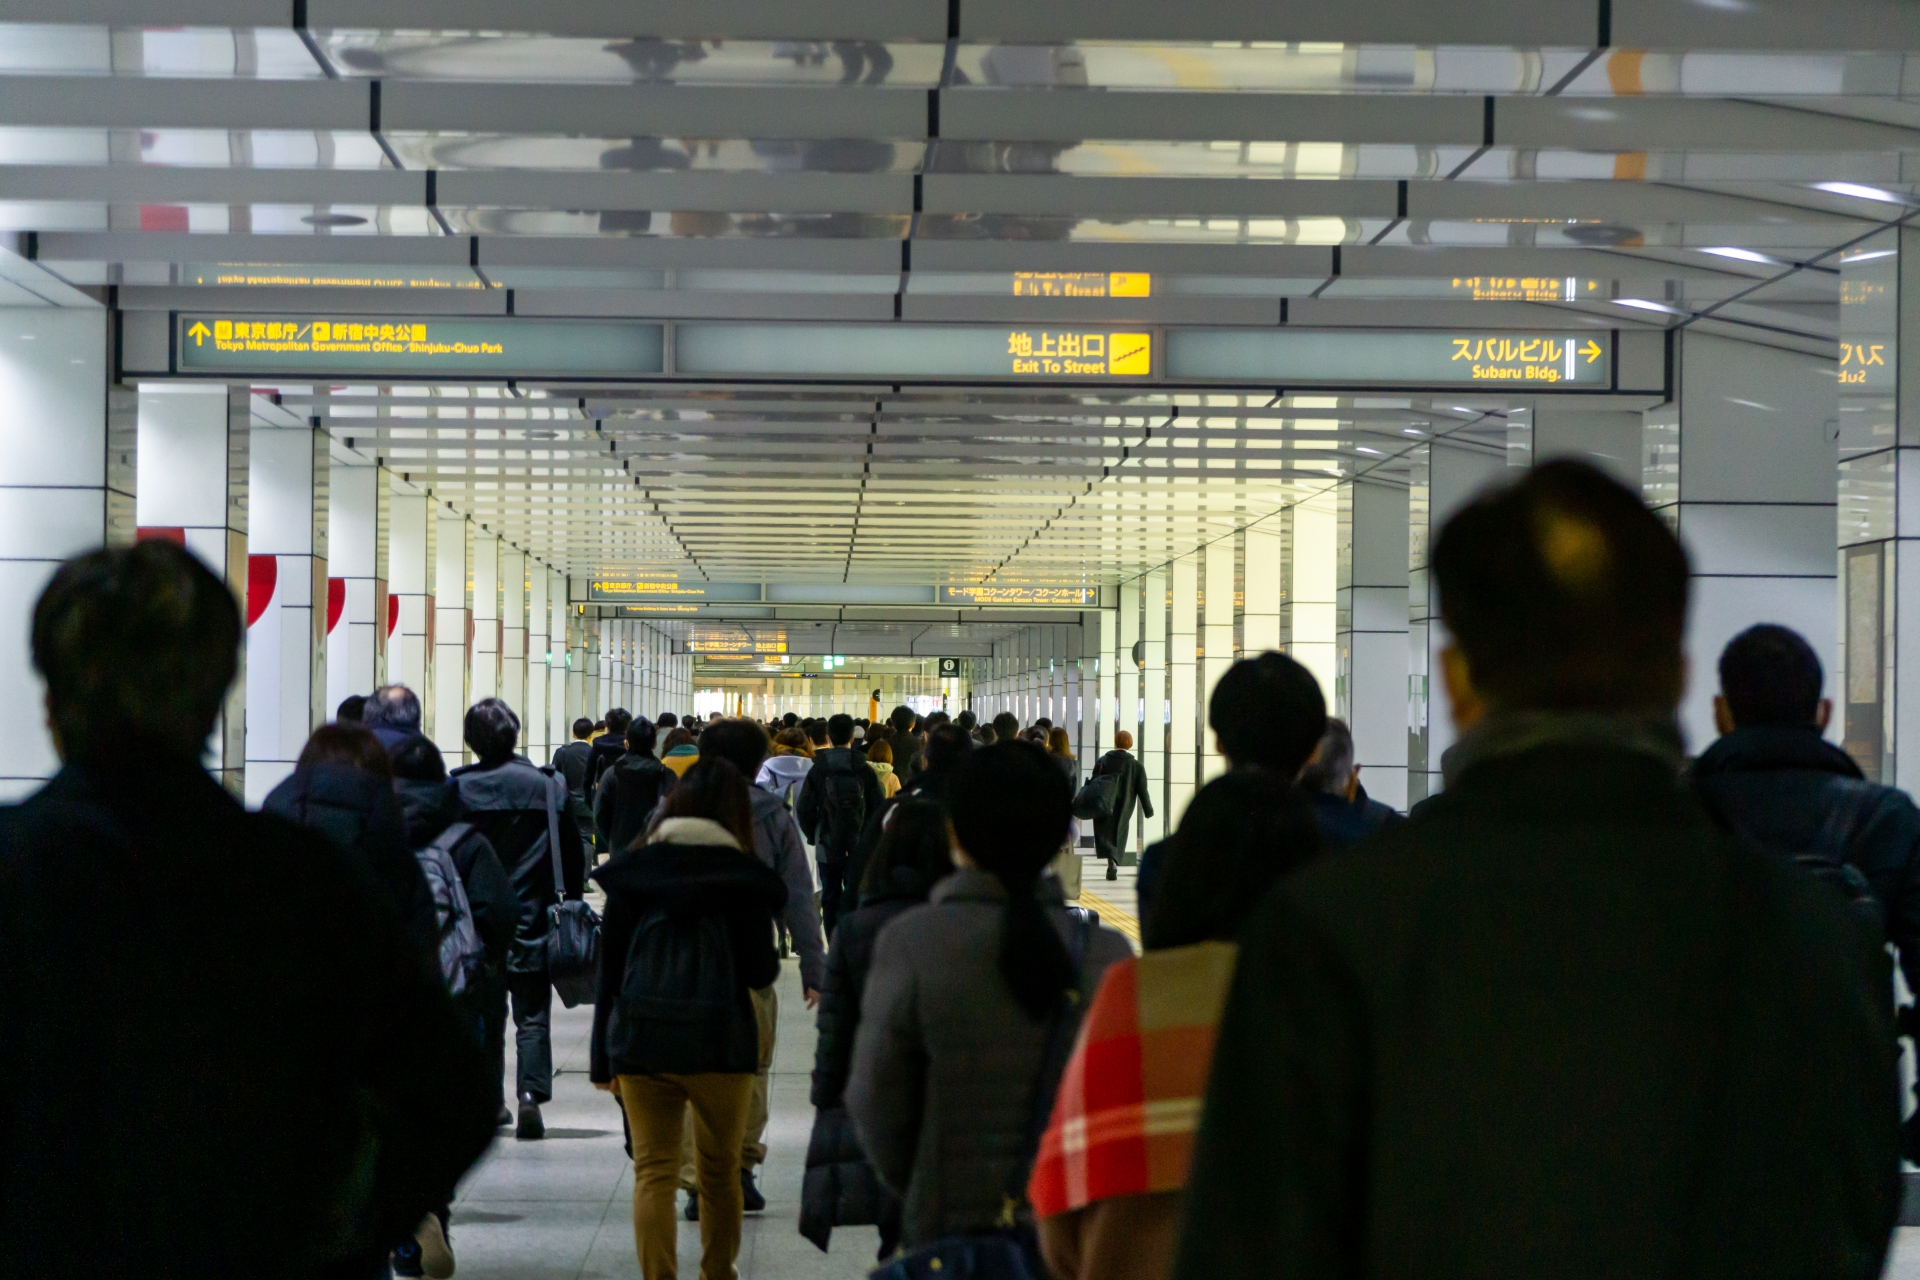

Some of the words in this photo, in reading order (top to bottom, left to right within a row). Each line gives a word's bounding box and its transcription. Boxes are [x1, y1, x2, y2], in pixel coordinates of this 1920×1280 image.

[332, 323, 427, 341] 新宿中央公園
[216, 340, 245, 352] Tokyo
[246, 340, 310, 352] Metropolitan
[311, 341, 371, 352] Government
[481, 343, 503, 354] Park
[1008, 332, 1105, 357] 地上出口
[1451, 338, 1563, 362] スバルビル
[1013, 359, 1039, 374] Exit
[1042, 359, 1061, 374] To
[1063, 359, 1106, 374] Street
[1472, 364, 1522, 379] Subaru
[1525, 364, 1562, 382] Bldg.
